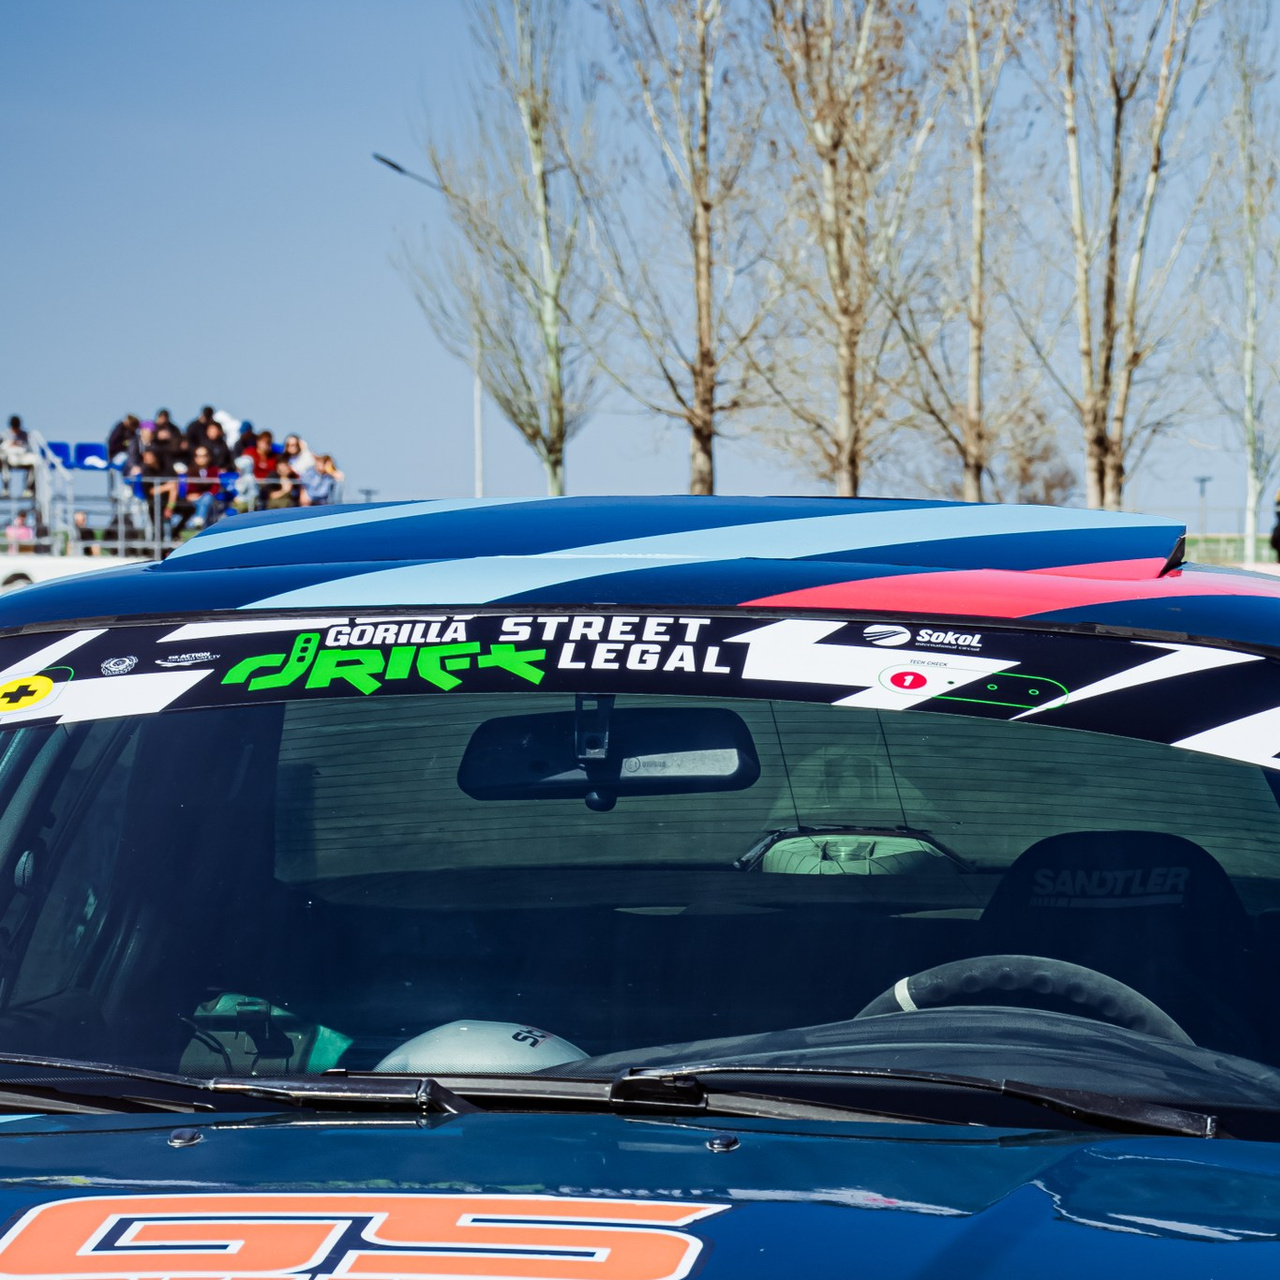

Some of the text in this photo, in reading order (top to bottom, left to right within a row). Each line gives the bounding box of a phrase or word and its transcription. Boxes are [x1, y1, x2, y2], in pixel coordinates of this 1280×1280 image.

[325, 621, 467, 646] GORILLA
[498, 616, 711, 642] STREET
[557, 642, 731, 673] LEGAL
[903, 675, 914, 686] 1
